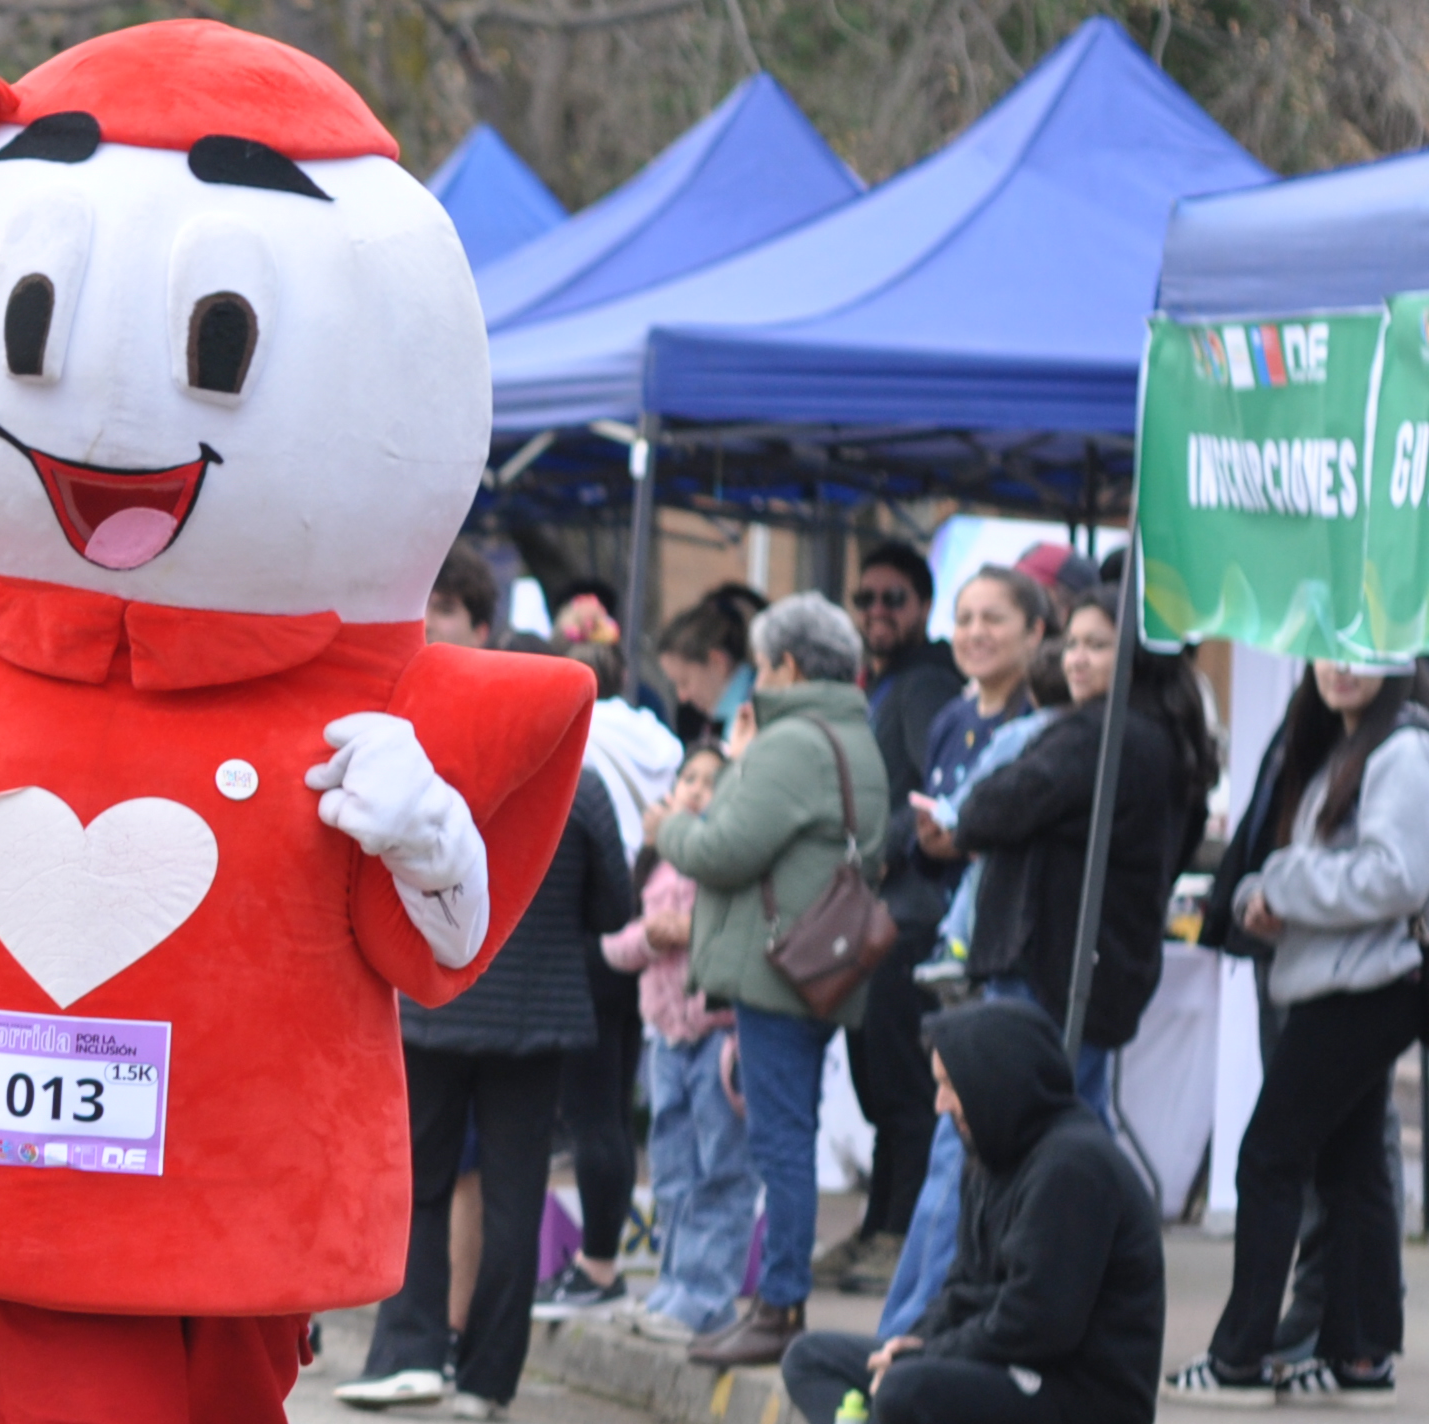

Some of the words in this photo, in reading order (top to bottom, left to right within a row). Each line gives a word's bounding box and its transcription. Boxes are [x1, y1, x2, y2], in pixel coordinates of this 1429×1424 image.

[1186, 431, 1360, 521] INSCRIPCIONES
[1390, 419, 1429, 510] GU
[75, 1042, 138, 1057] INCLUSIÓN
[76, 1033, 100, 1044] POR
[102, 1034, 116, 1044] LA
[112, 1063, 154, 1082] 1.5K
[5, 1072, 105, 1123] 013
